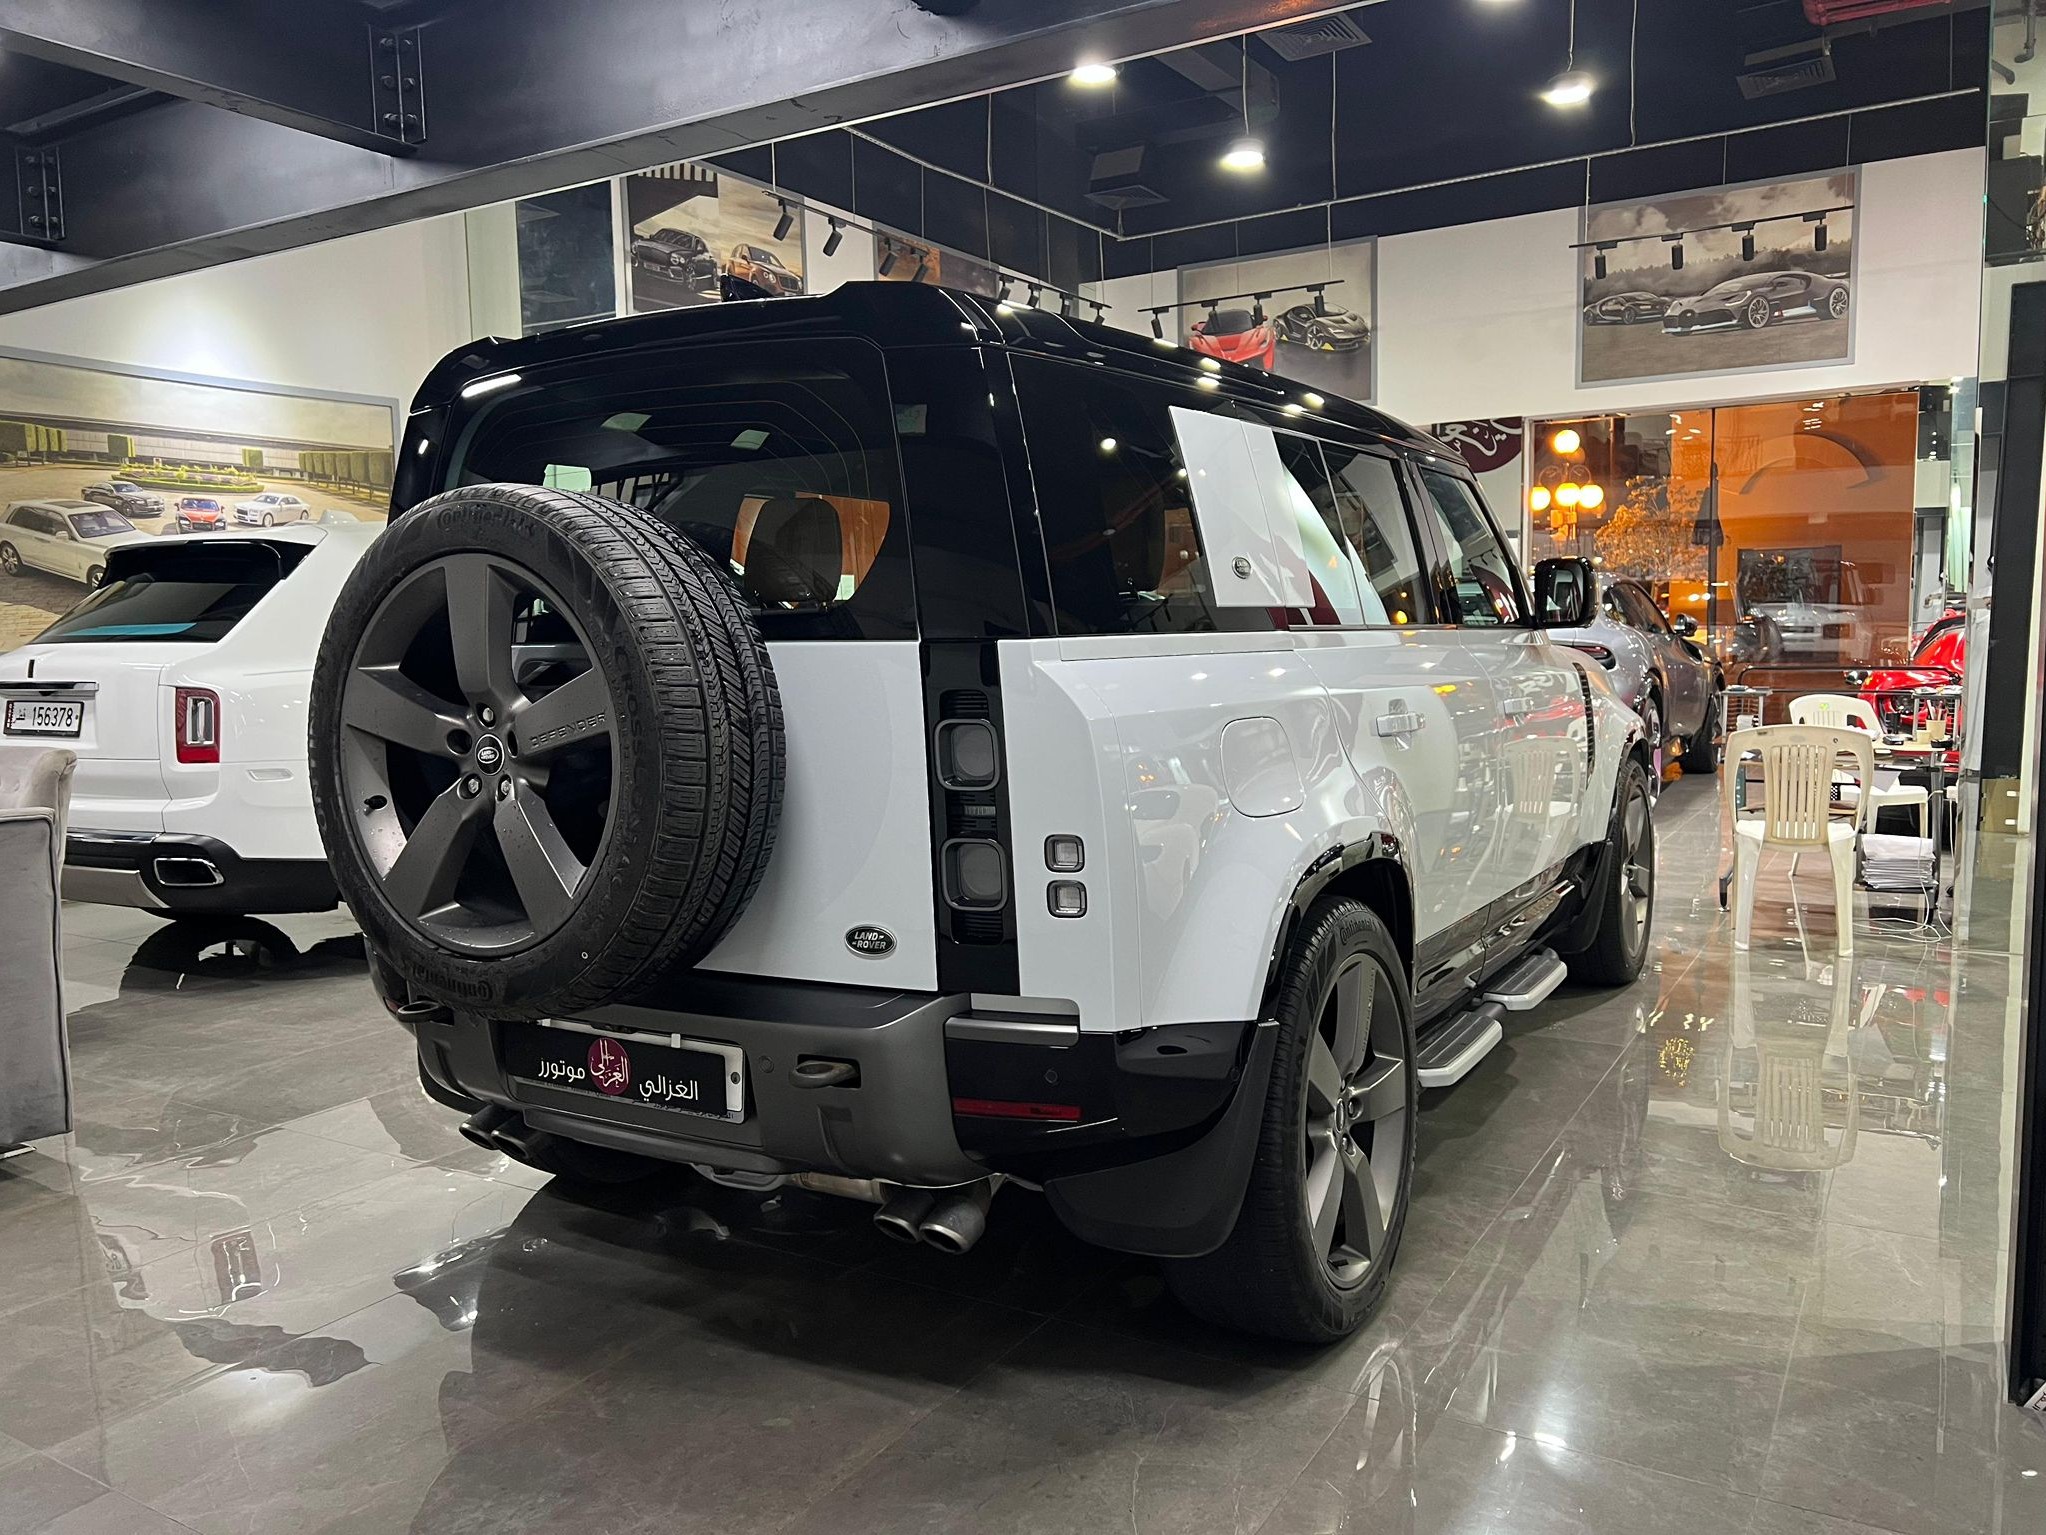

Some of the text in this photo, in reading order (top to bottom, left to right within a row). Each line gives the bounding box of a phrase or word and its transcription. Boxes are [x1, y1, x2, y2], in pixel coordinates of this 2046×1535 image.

[32, 705, 74, 728] 156378
[528, 710, 608, 749] DEFENDER
[538, 1057, 586, 1082] موتورز
[639, 1074, 699, 1101] الغزالي
